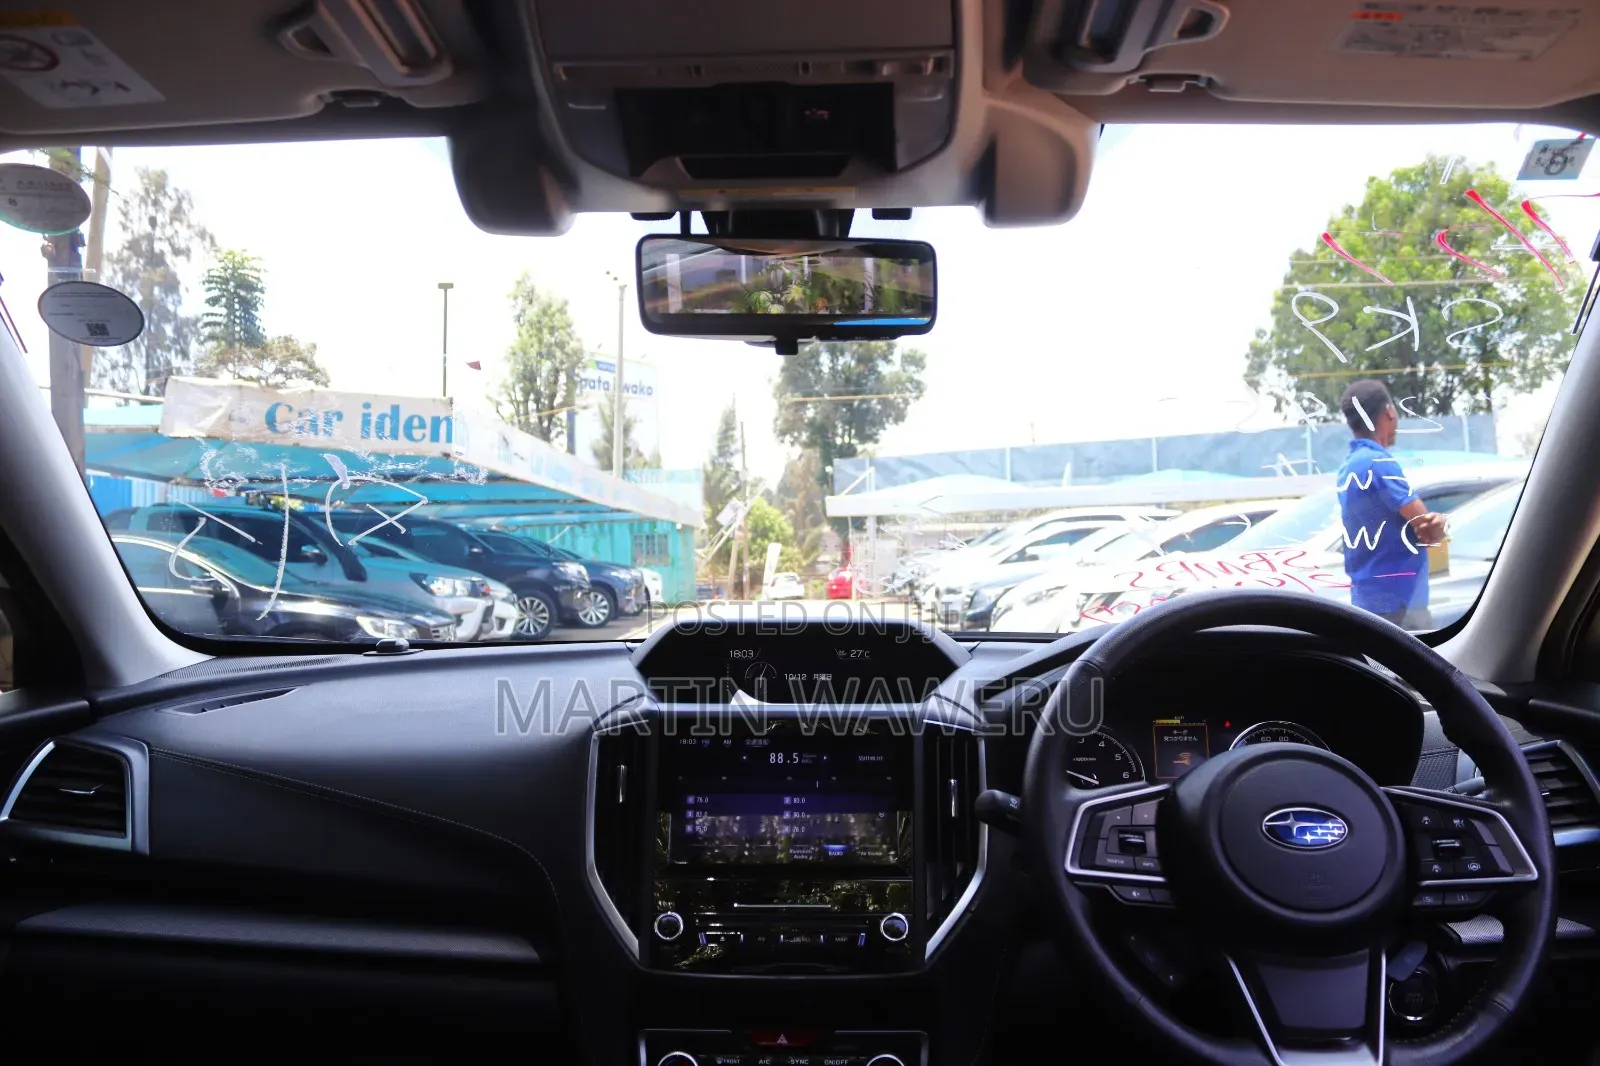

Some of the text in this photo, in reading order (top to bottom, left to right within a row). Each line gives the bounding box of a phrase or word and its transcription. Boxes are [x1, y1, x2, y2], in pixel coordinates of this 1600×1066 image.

[580, 376, 610, 396] pata
[265, 401, 344, 439] Car
[729, 650, 754, 658] 18:03
[1098, 740, 1105, 748] 4
[769, 752, 799, 764] 88.5
[1115, 753, 1122, 761] 5
[1122, 771, 1130, 779] 6
